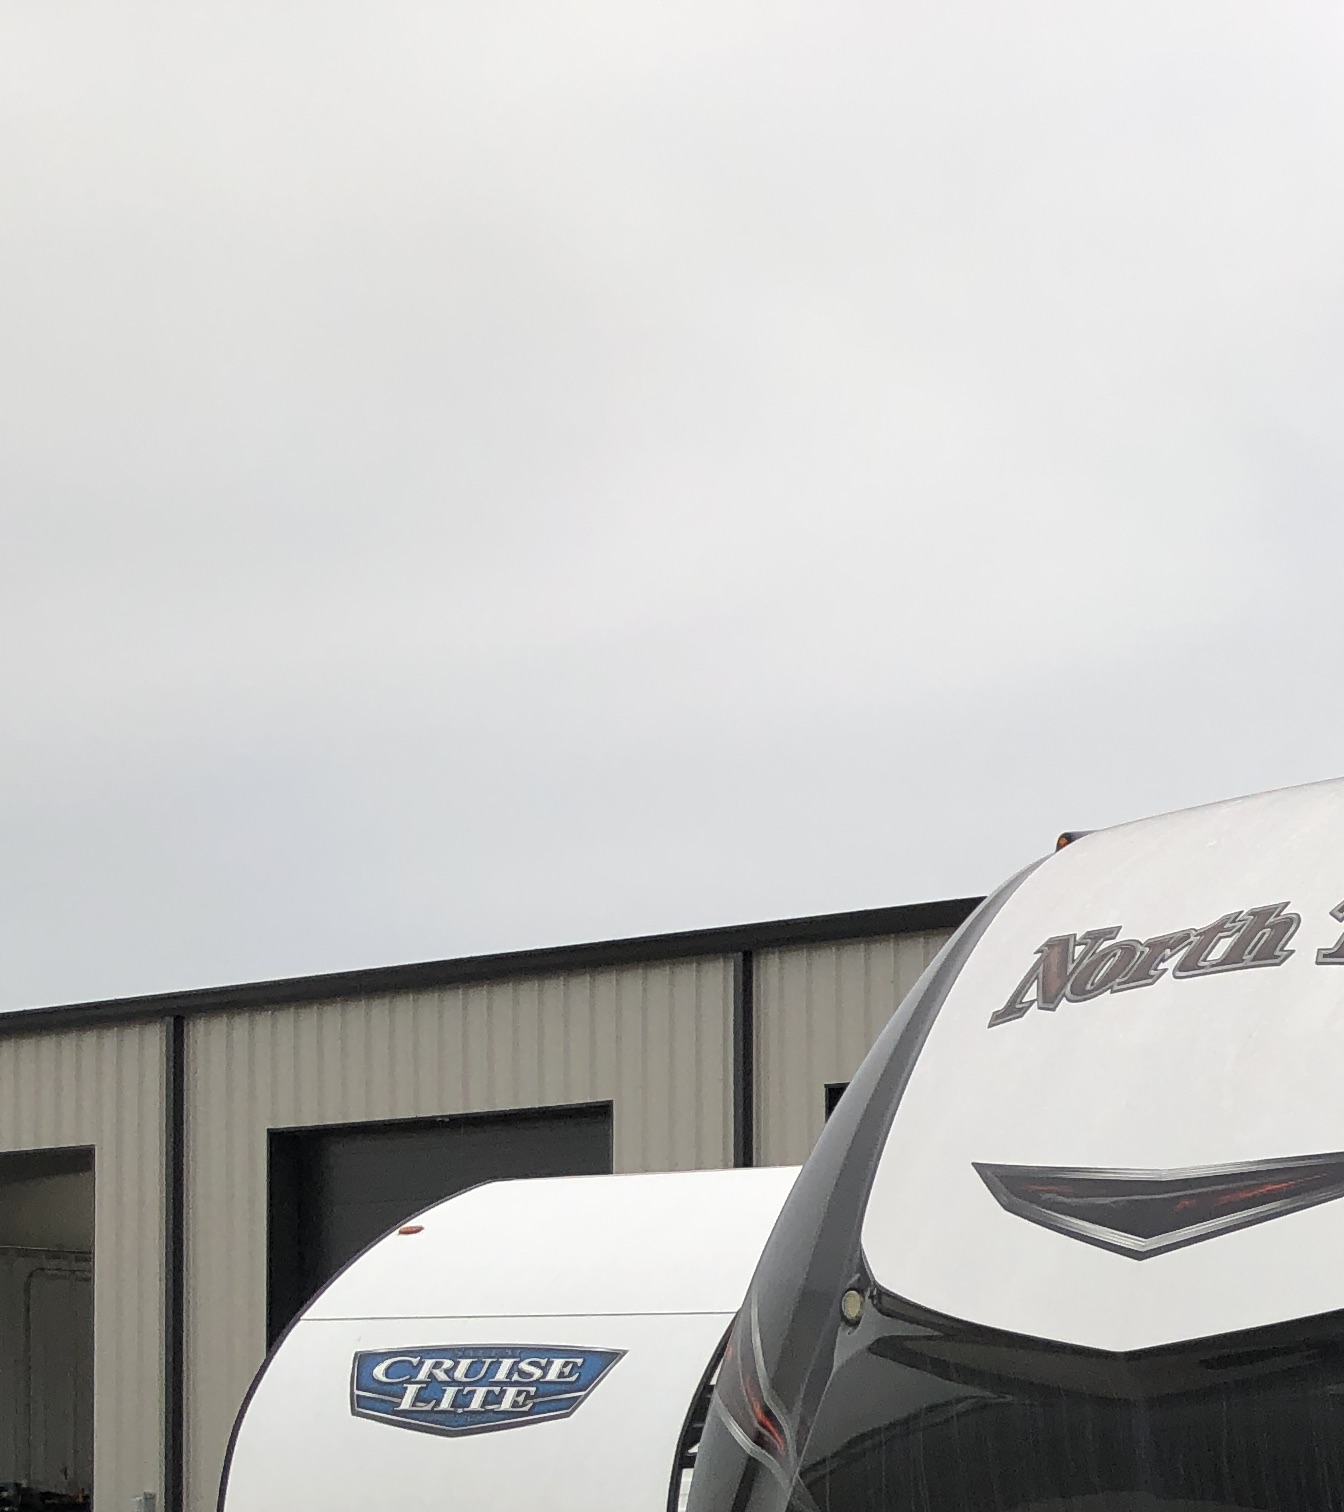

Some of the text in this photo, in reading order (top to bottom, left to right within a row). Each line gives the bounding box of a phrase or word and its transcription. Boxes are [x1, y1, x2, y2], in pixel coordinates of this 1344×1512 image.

[988, 901, 1300, 1028] North
[372, 1356, 584, 1382] CRUISE
[394, 1383, 537, 1413] LITE
